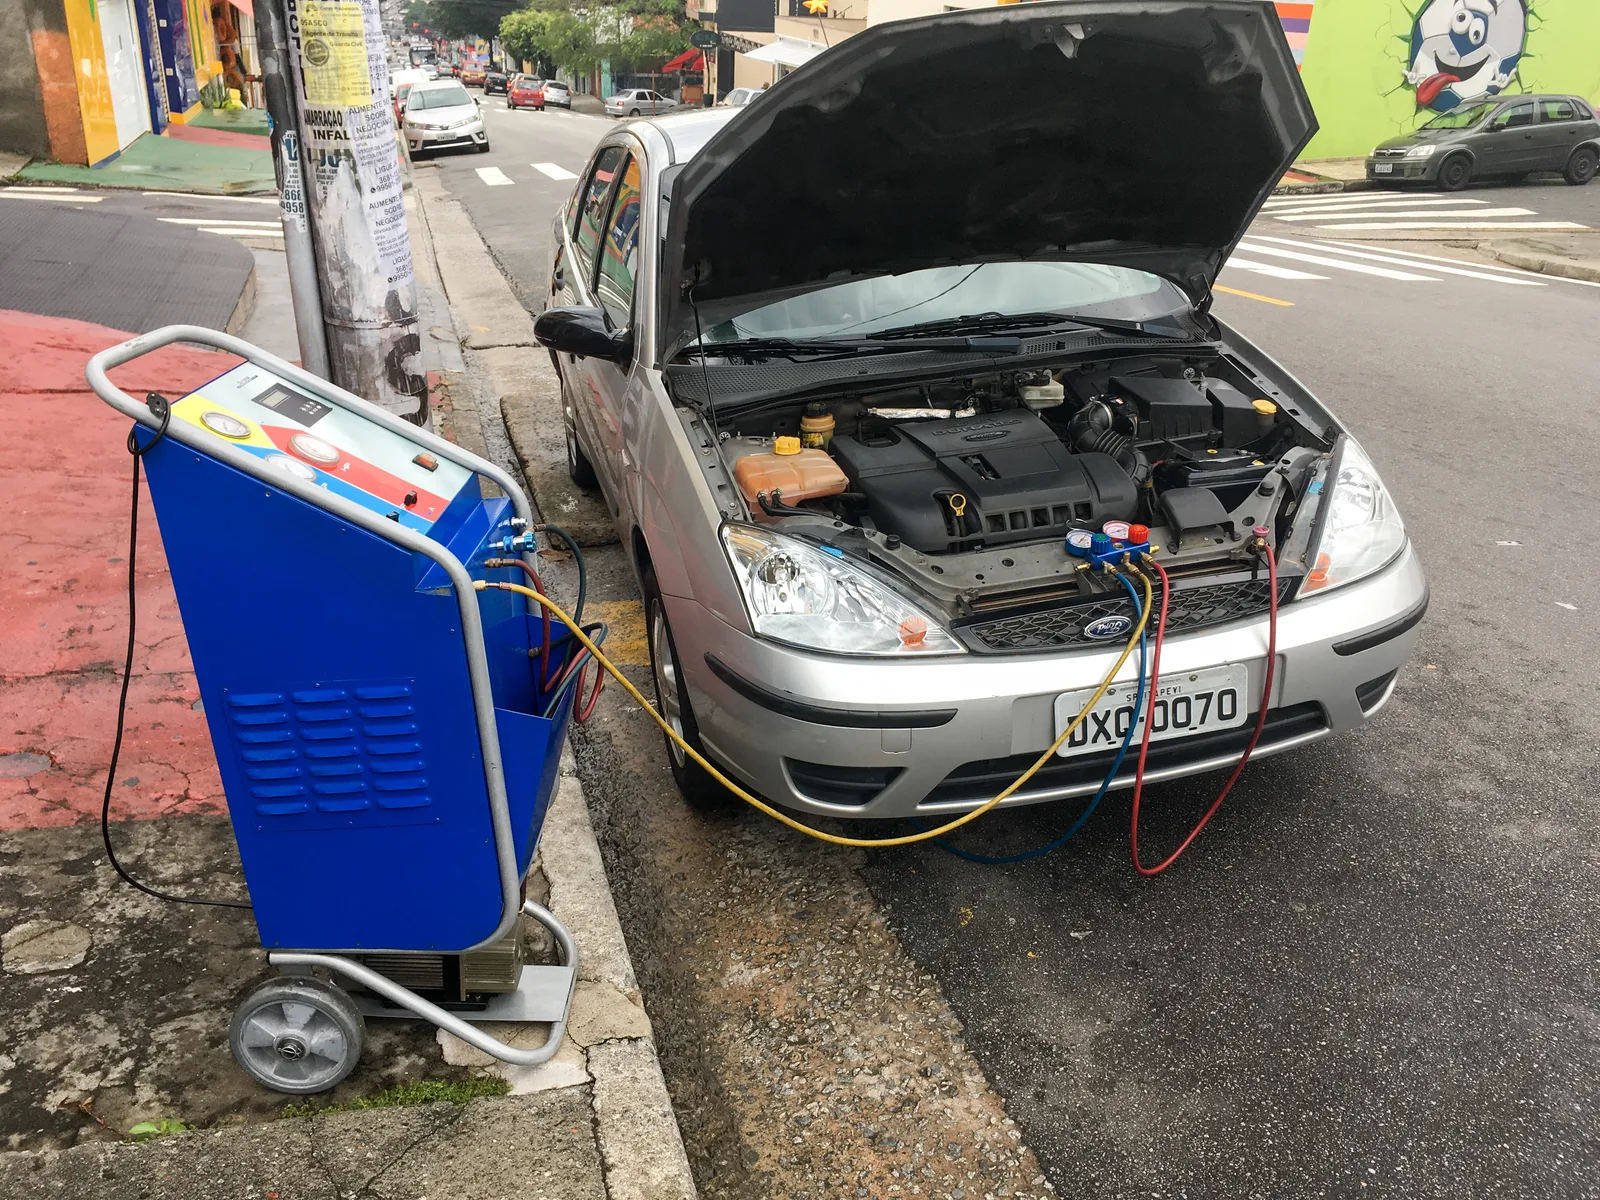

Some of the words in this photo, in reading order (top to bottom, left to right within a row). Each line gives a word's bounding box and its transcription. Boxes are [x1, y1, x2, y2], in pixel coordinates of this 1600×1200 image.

[348, 101, 383, 115] AUMENTE
[365, 109, 387, 121] SCORE
[313, 129, 350, 140] INFAL
[374, 163, 392, 174] LIGUE
[369, 195, 398, 210] AUMENTE
[1096, 620, 1123, 634] Ford
